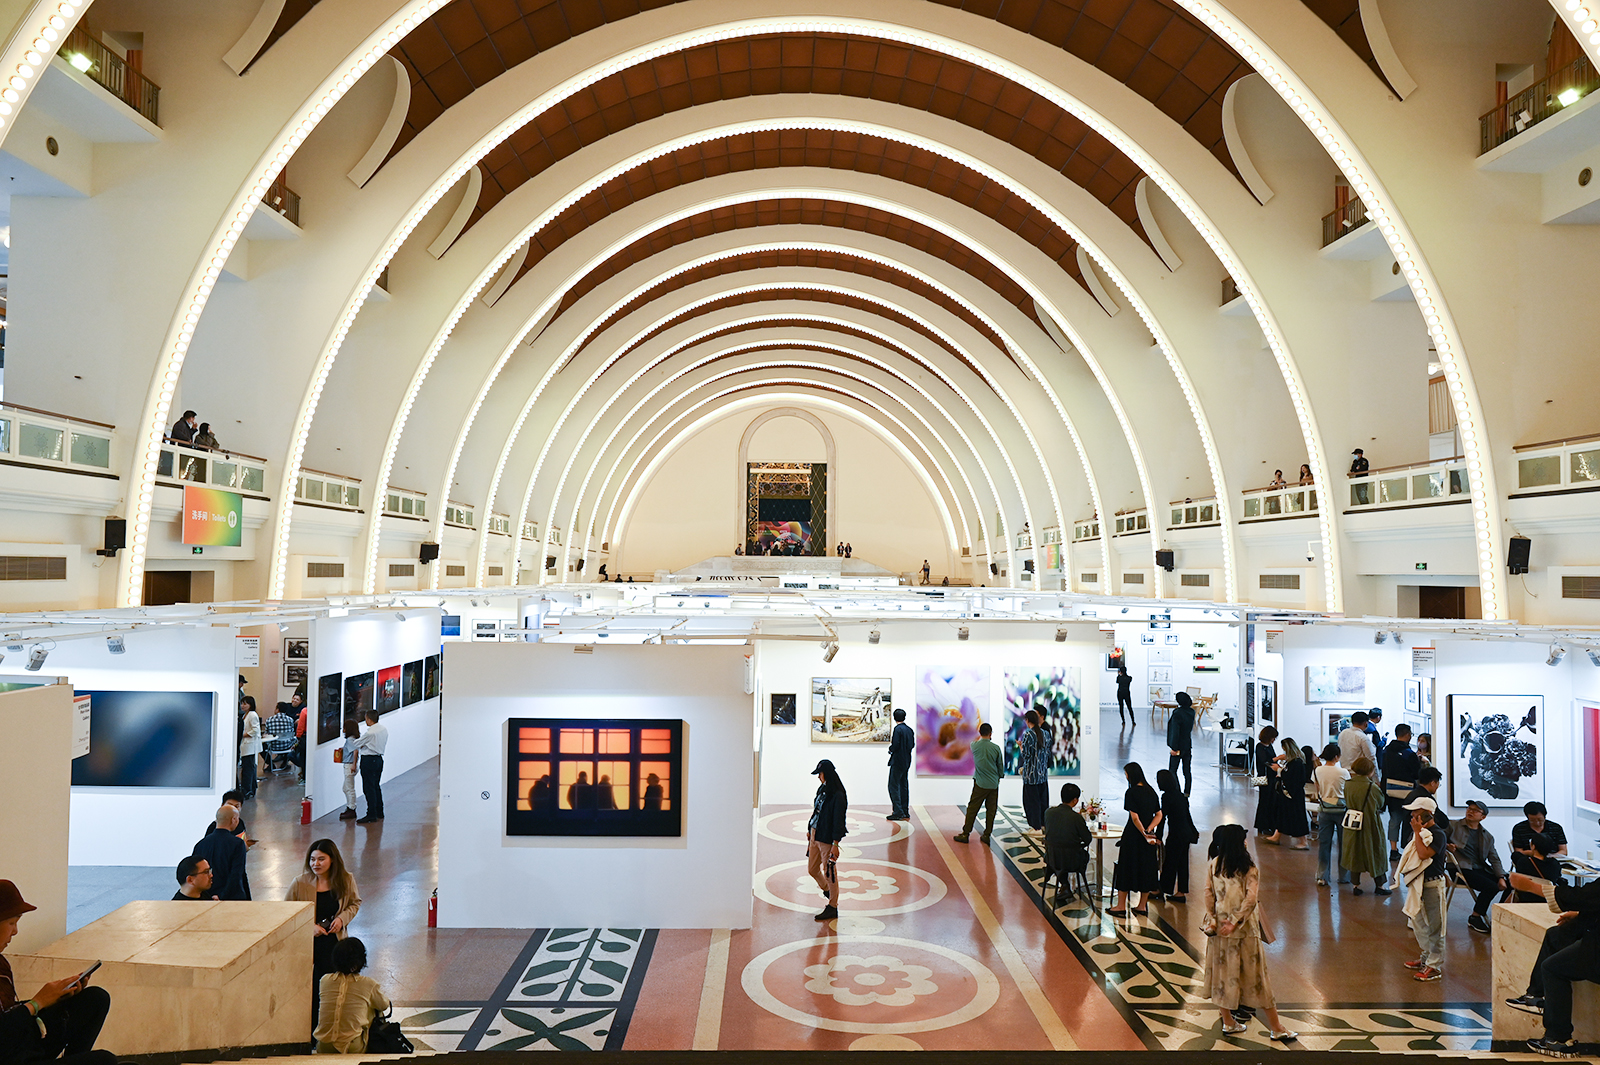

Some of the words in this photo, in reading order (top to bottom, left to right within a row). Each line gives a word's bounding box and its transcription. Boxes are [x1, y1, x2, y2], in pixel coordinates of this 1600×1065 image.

[191, 510, 208, 521] 洗手间
[212, 513, 227, 522] Toilets
